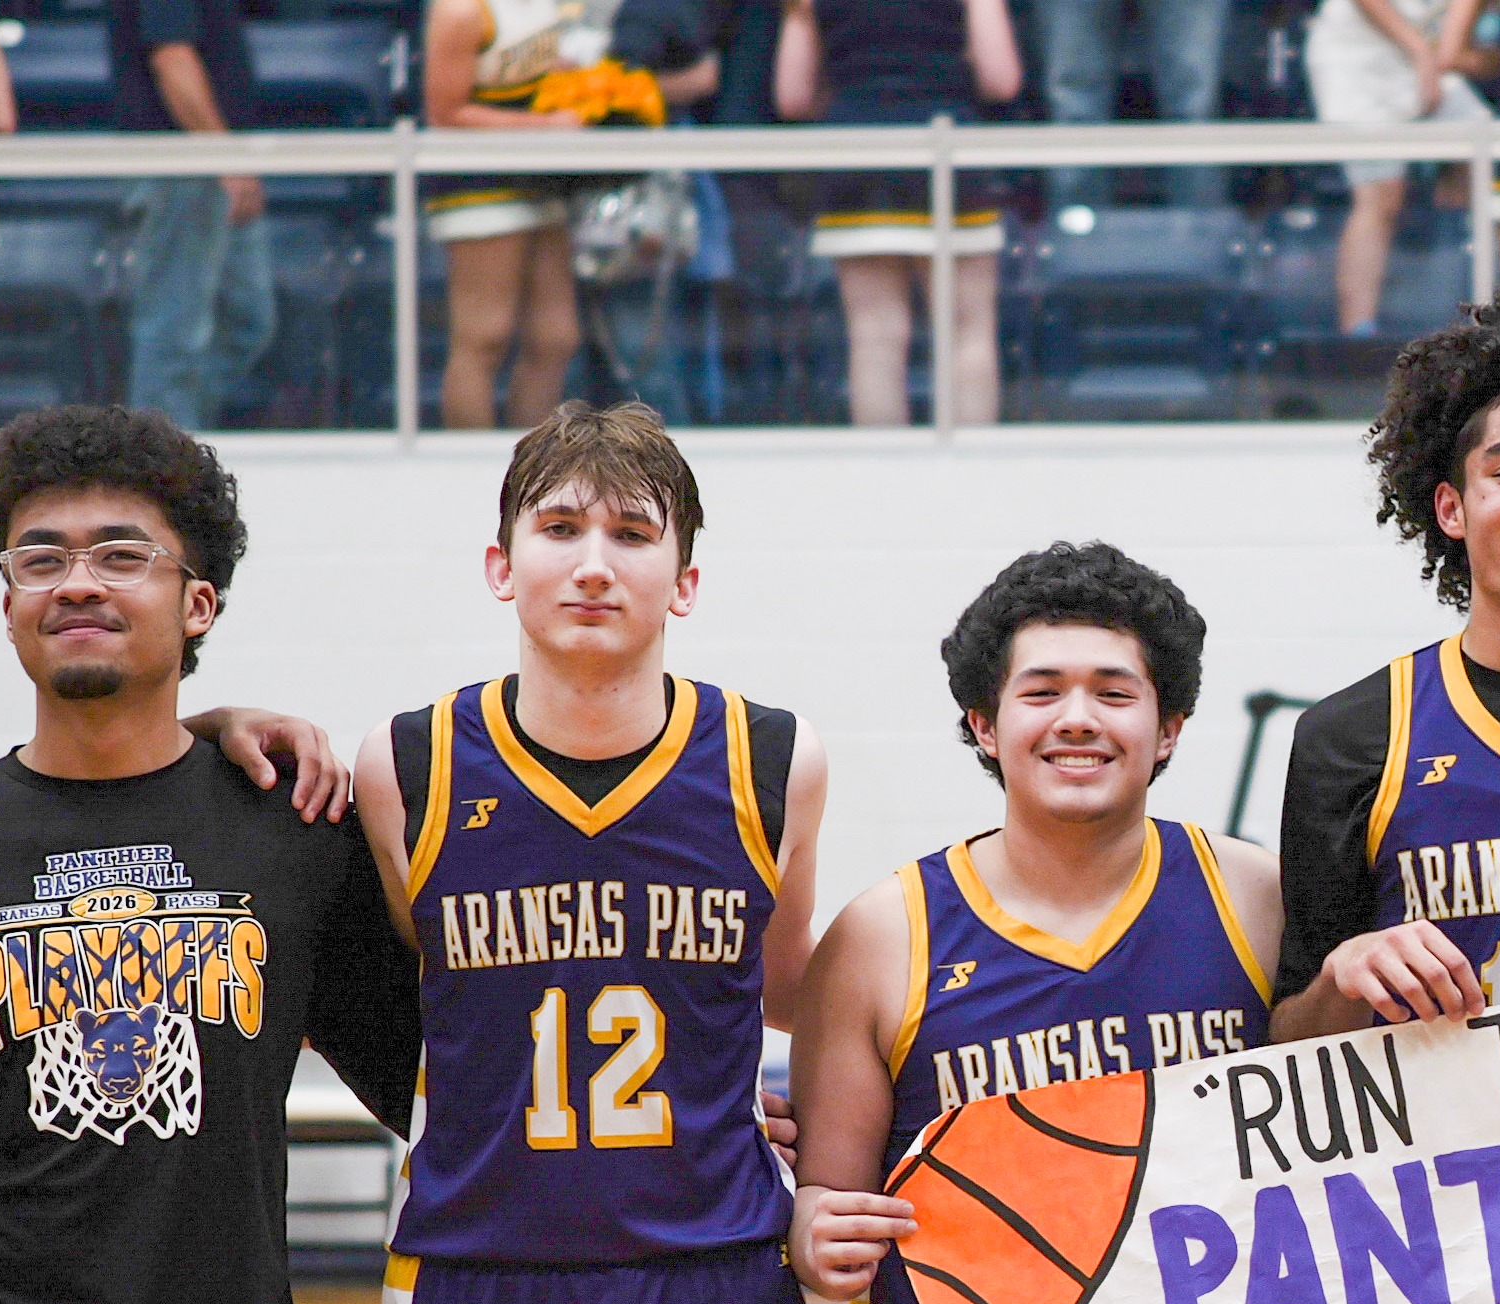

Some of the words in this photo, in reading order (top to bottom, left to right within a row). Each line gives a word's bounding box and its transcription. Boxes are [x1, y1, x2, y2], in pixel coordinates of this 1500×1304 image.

[34, 863, 191, 900] BASKETBALL
[46, 845, 172, 873] PANTHER
[87, 895, 136, 913] 2026
[165, 894, 219, 909] PASS
[441, 880, 625, 970] ARANSAS
[645, 883, 747, 964] PASS
[525, 984, 674, 1150] 12
[933, 1016, 1131, 1110] ARANSAS
